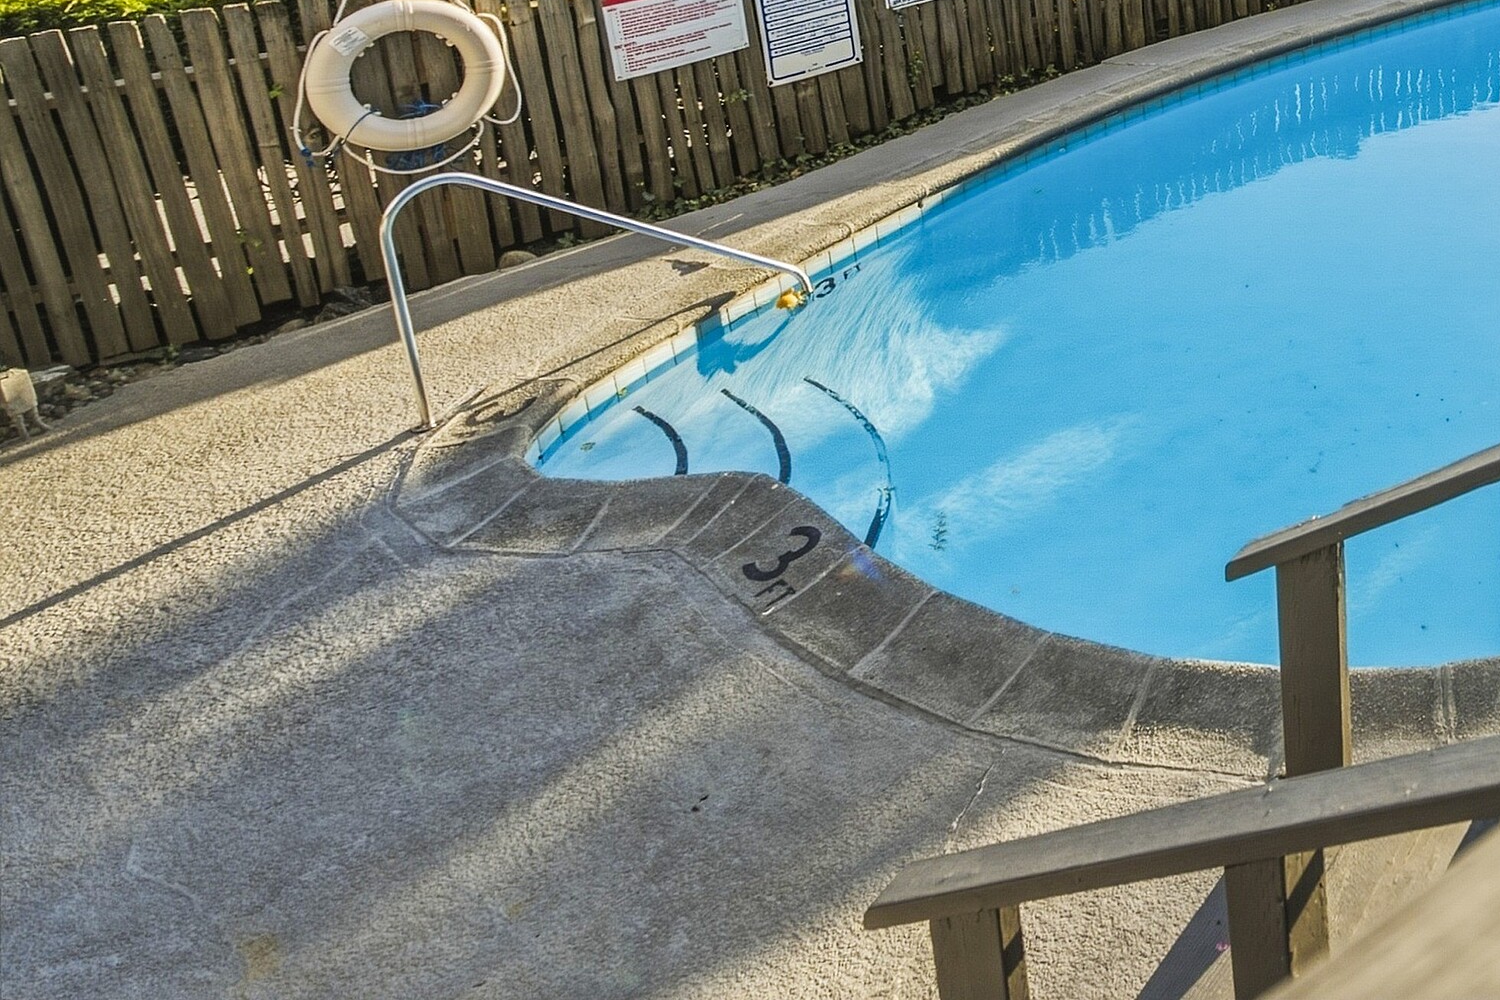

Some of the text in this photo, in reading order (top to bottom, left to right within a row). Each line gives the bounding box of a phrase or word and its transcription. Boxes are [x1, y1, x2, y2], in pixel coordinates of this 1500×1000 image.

[815, 262, 861, 298] 3 FT
[742, 526, 822, 581] 3
[752, 579, 796, 608] FT
